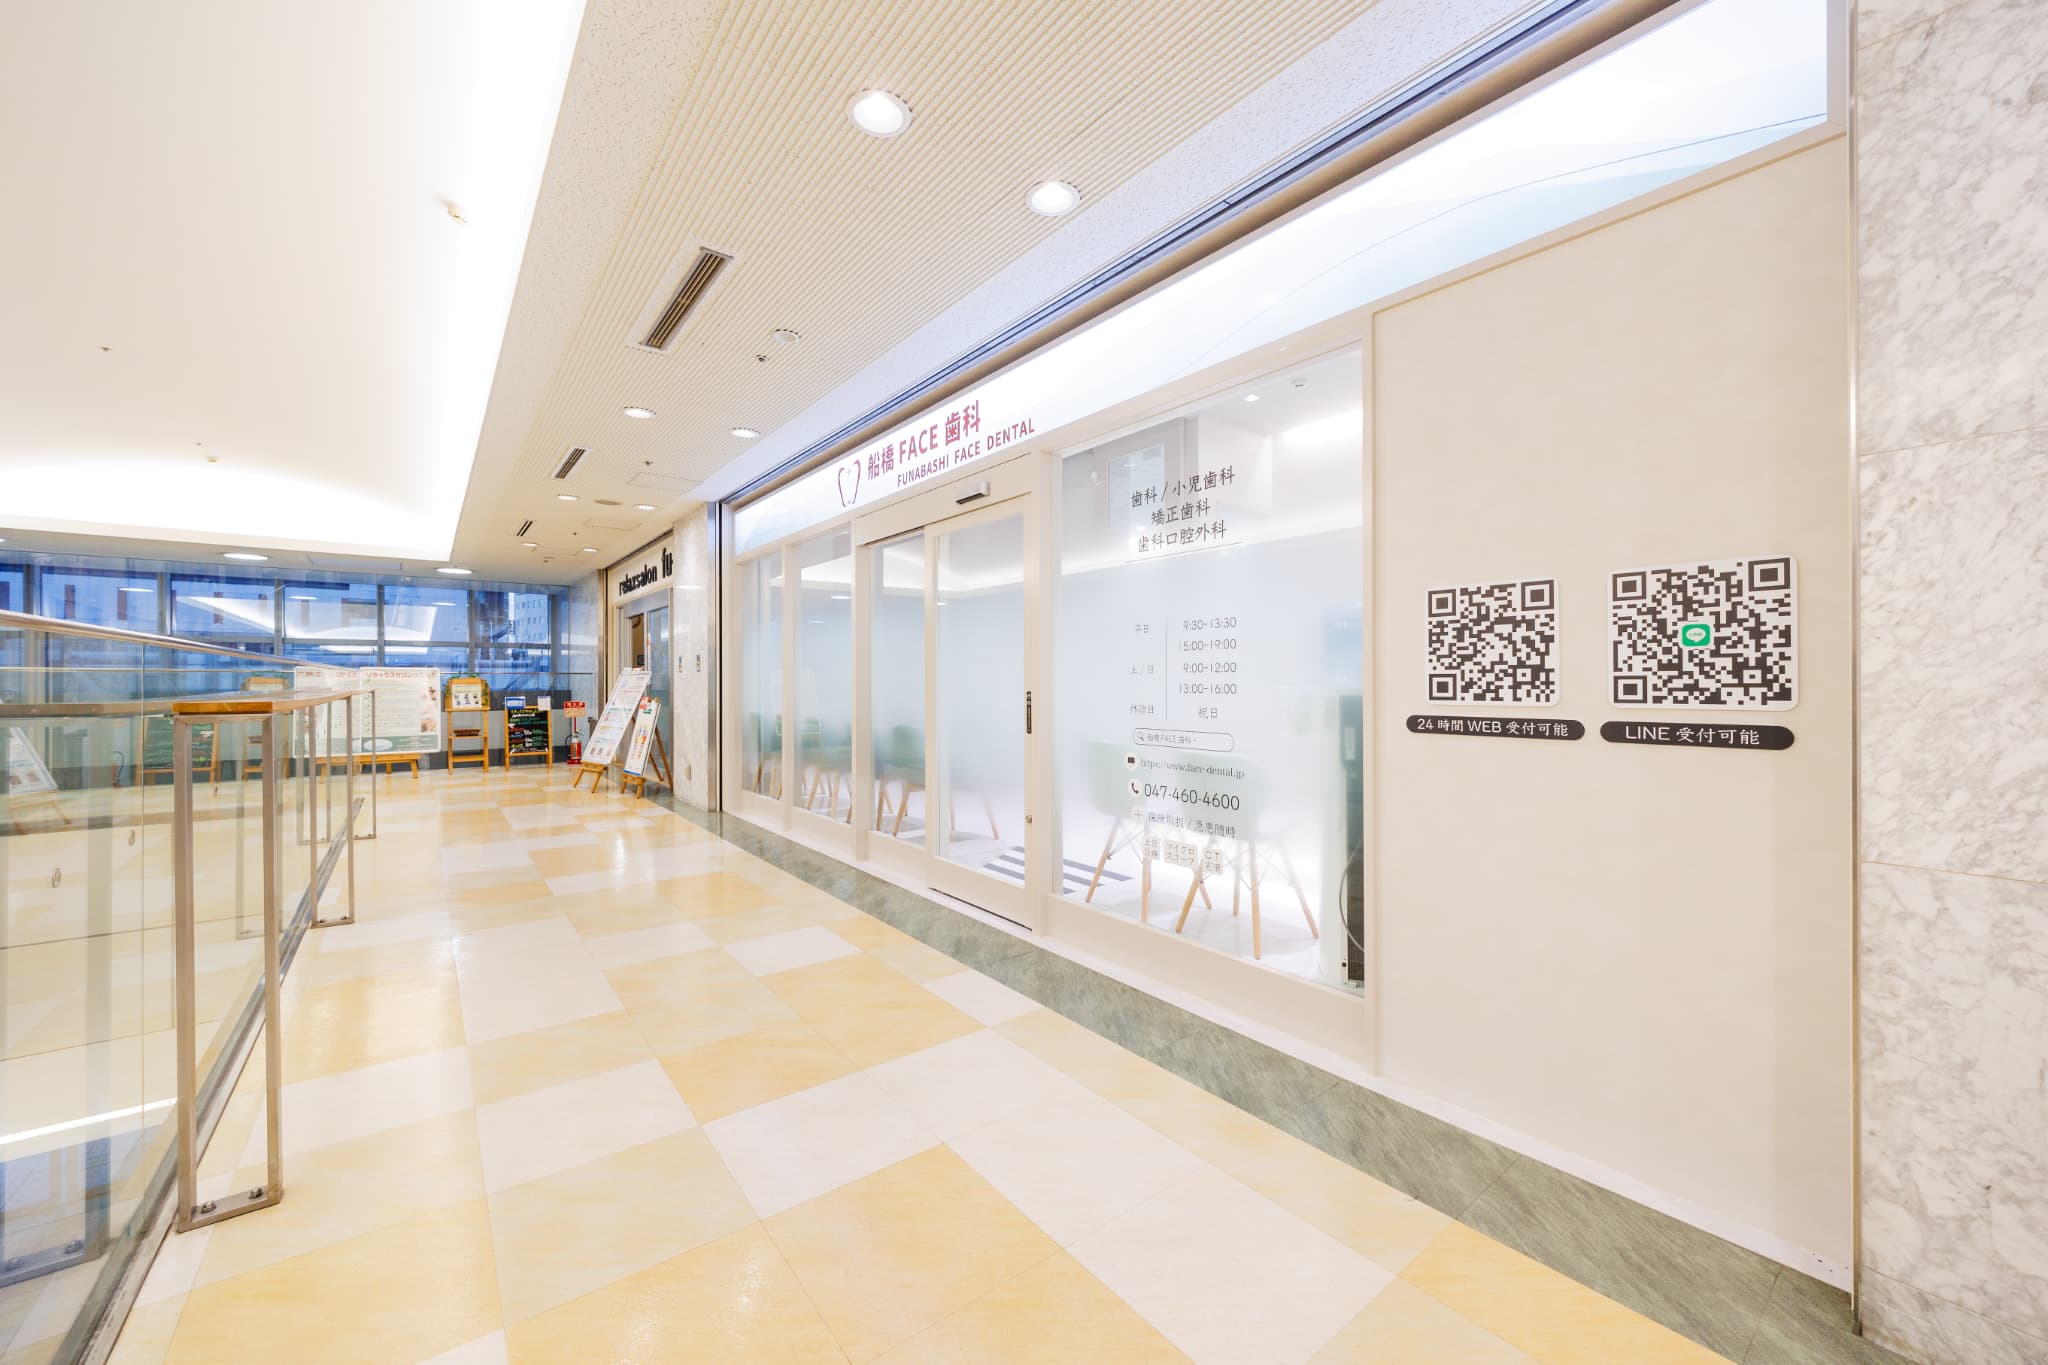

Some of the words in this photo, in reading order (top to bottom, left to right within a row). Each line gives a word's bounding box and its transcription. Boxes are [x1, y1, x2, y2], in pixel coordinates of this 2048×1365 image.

[867, 444, 894, 480] 船橋
[899, 424, 938, 464] FACE
[945, 400, 980, 446] 歯科
[897, 454, 949, 487] FUNABASHI
[954, 440, 980, 464] FACE
[987, 418, 1035, 451] DENTAL
[1151, 497, 1210, 525] 矯正歯科
[1138, 520, 1227, 552] 歯科口腔外科
[1417, 718, 1434, 730] 24
[1437, 719, 1464, 732] 時間
[1467, 720, 1502, 733] WEB
[1506, 721, 1569, 737] 受付可能
[1625, 725, 1671, 740] LINE
[1676, 727, 1760, 745] 受付可能
[1144, 783, 1240, 810] 047-460-4600
